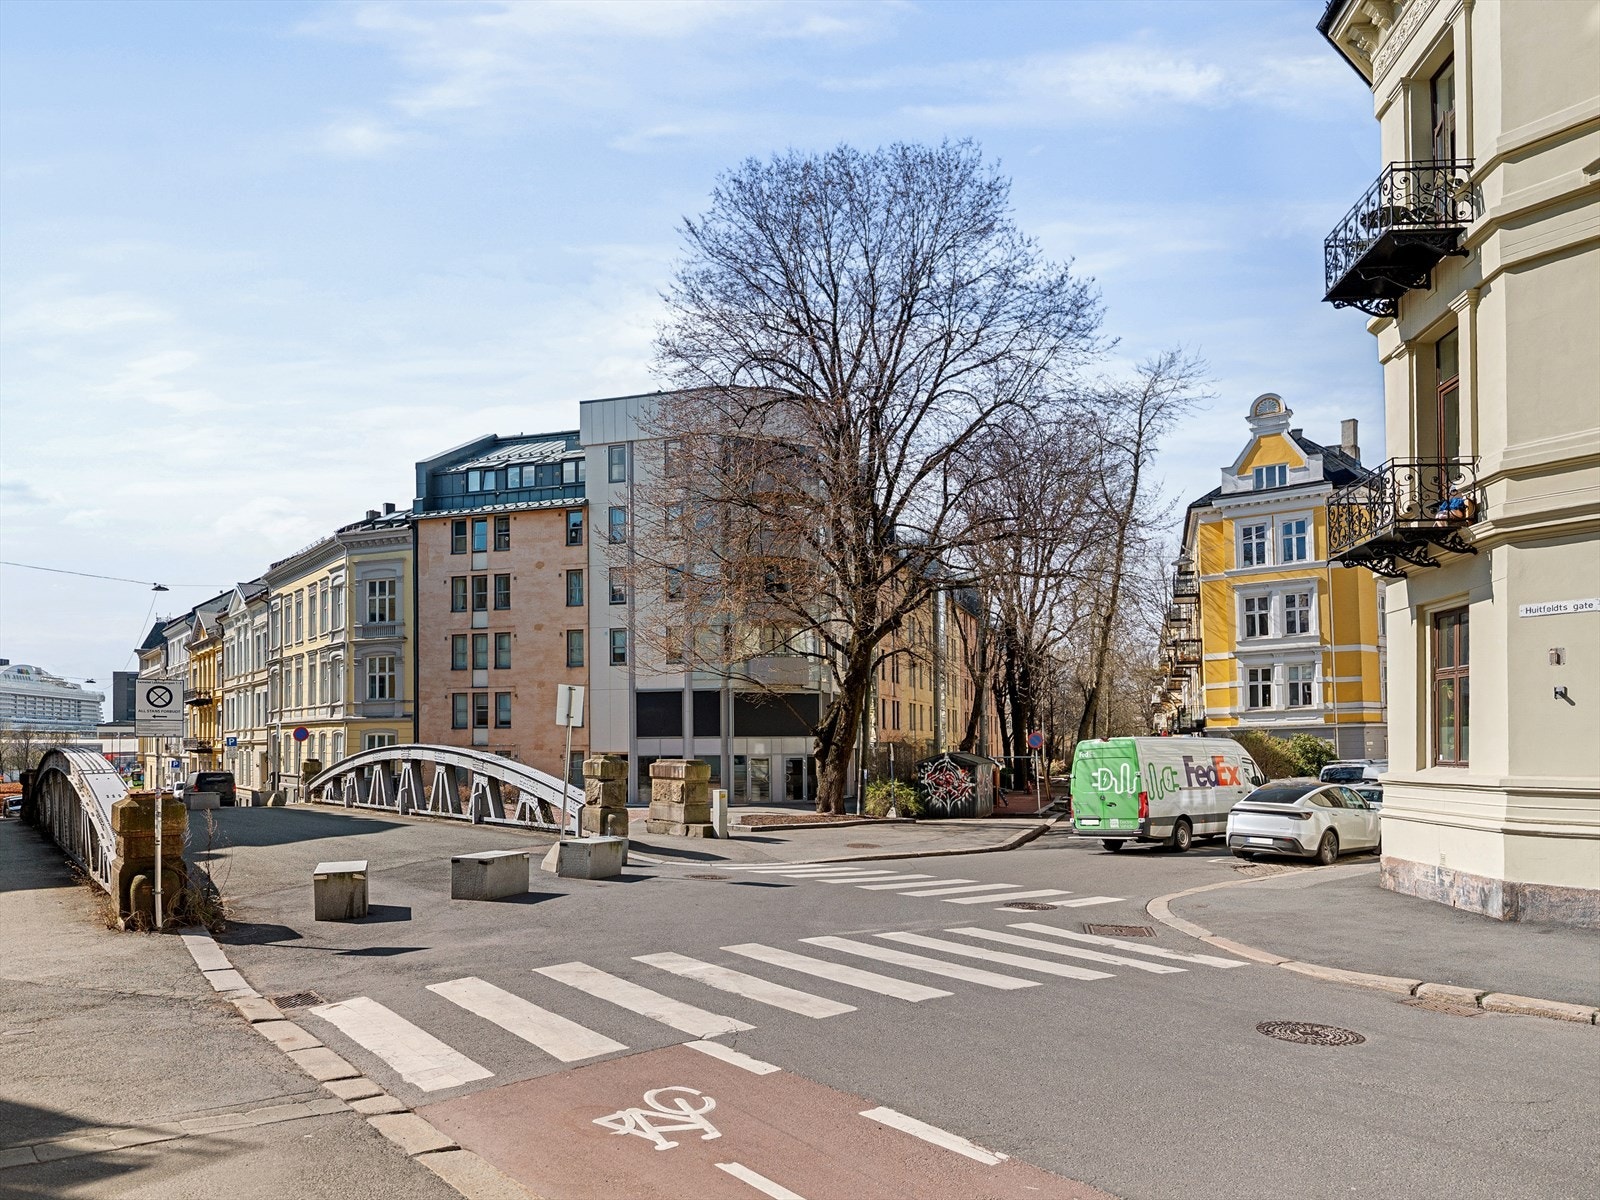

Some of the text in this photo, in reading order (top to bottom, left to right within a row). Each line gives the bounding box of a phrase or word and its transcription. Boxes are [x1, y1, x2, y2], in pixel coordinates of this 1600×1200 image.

[1525, 604, 1568, 614] Huitfeldts
[1572, 602, 1594, 612] gate
[1182, 755, 1241, 787] FedEx
